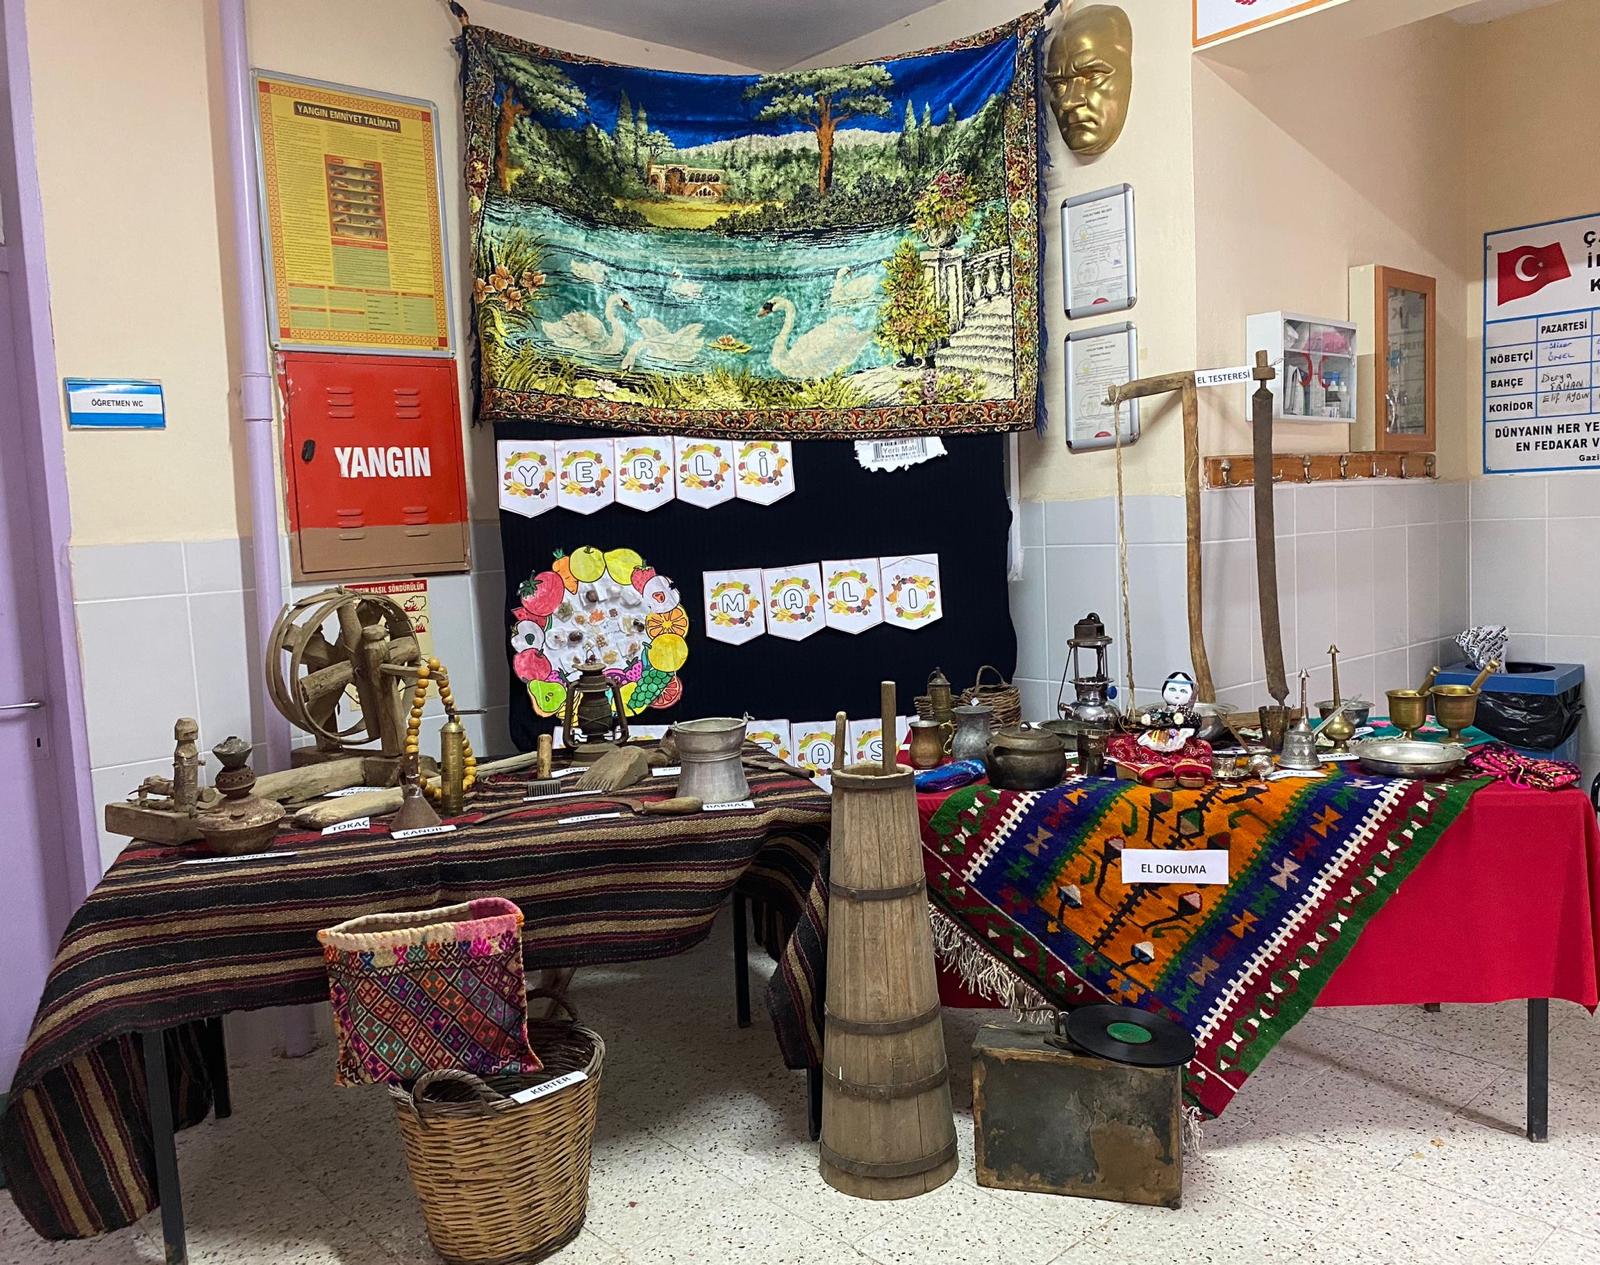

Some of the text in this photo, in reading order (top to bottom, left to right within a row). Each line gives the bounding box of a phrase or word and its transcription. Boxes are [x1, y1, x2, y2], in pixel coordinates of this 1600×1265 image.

[296, 105, 398, 130] YANGIN EMNİYET TALİMATI
[1541, 318, 1588, 334] PAZARTESİ
[1490, 349, 1533, 364] NÖBETÇİ
[1197, 370, 1251, 384] EL TESTERESİ
[1490, 378, 1523, 389] BAHÇE
[91, 398, 131, 407] ÖĞRETMEN
[1489, 401, 1533, 413] KORİDOR
[1495, 425, 1552, 438] DÜNYANIN
[1557, 423, 1580, 434] HER
[1516, 442, 1530, 452] EN
[1534, 438, 1588, 451] FEDAKAR
[333, 446, 432, 478] YANGIN
[388, 583, 425, 593] SÖNDÜRÜLÜR
[331, 820, 369, 832] TOKAÇ
[1141, 863, 1207, 874] EL DOKUMA
[530, 1076, 572, 1095] KERTER
